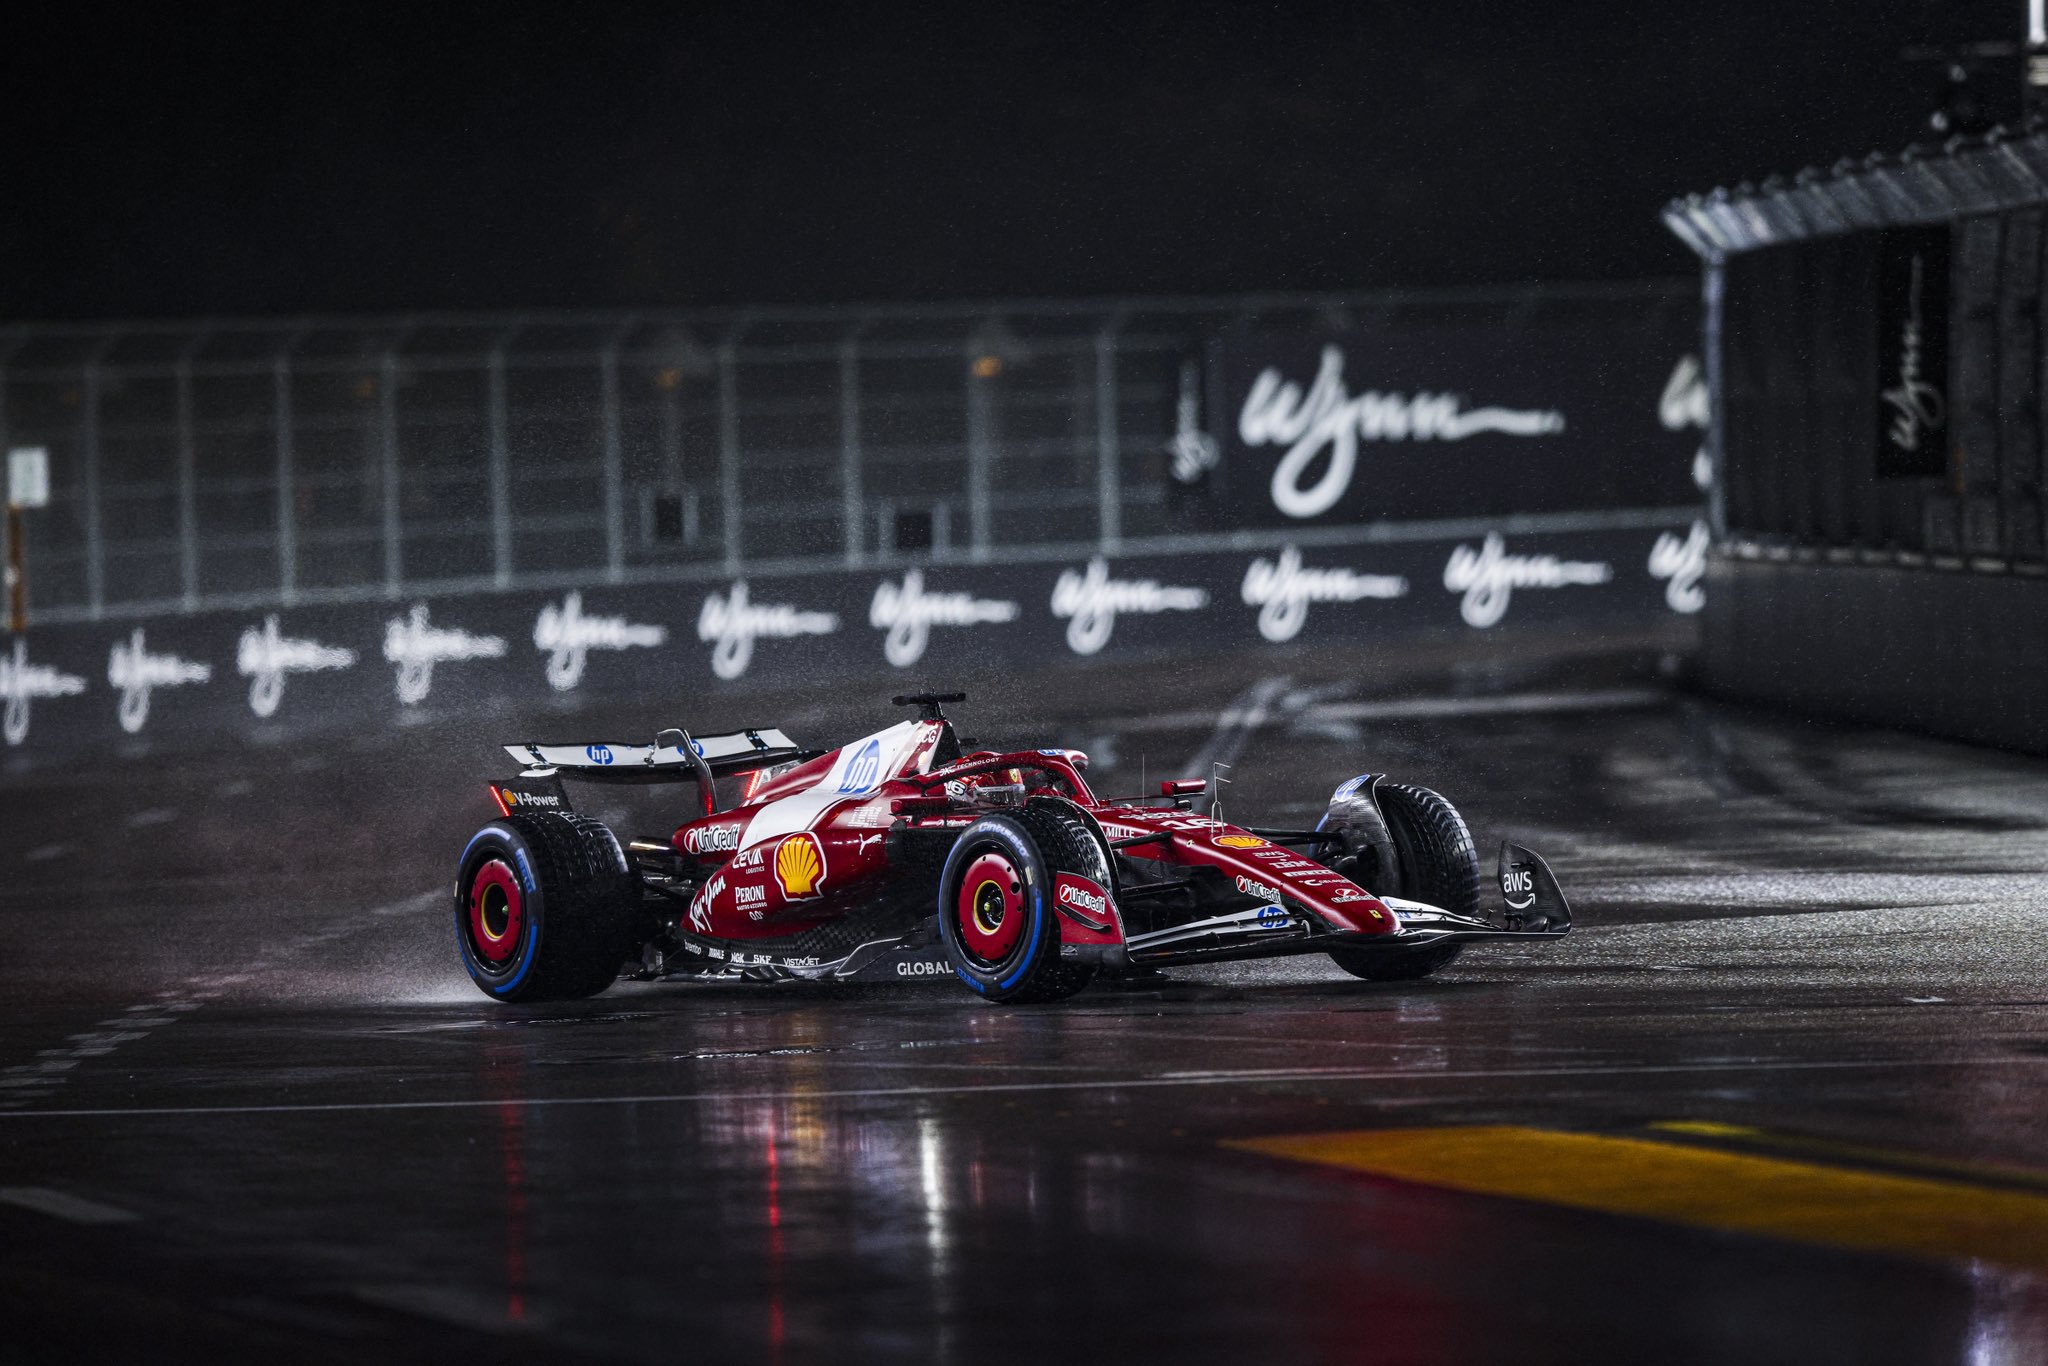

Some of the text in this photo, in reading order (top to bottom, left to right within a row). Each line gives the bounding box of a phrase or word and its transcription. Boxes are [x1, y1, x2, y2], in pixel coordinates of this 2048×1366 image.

[1239, 345, 1565, 517] Wynn
[1241, 543, 1408, 642] Wynn
[1443, 531, 1613, 628] Wynn
[869, 569, 1020, 668] Wynn
[1051, 556, 1208, 655] Wynn
[533, 591, 665, 691] Wynn
[699, 580, 838, 680] Wynn
[841, 740, 879, 793] hp
[957, 756, 1000, 769] TECHNOLOGY
[513, 792, 559, 806] V-Power
[697, 823, 741, 852] UniCredit
[1106, 826, 1135, 838] MILLE
[735, 885, 766, 904] PERONI
[1245, 878, 1281, 904] UniCredit
[1503, 871, 1533, 893] aws
[1071, 887, 1105, 914] UniCredit
[730, 952, 745, 963] NGK
[753, 954, 772, 964] SKF
[897, 961, 954, 976] GLOBAL
